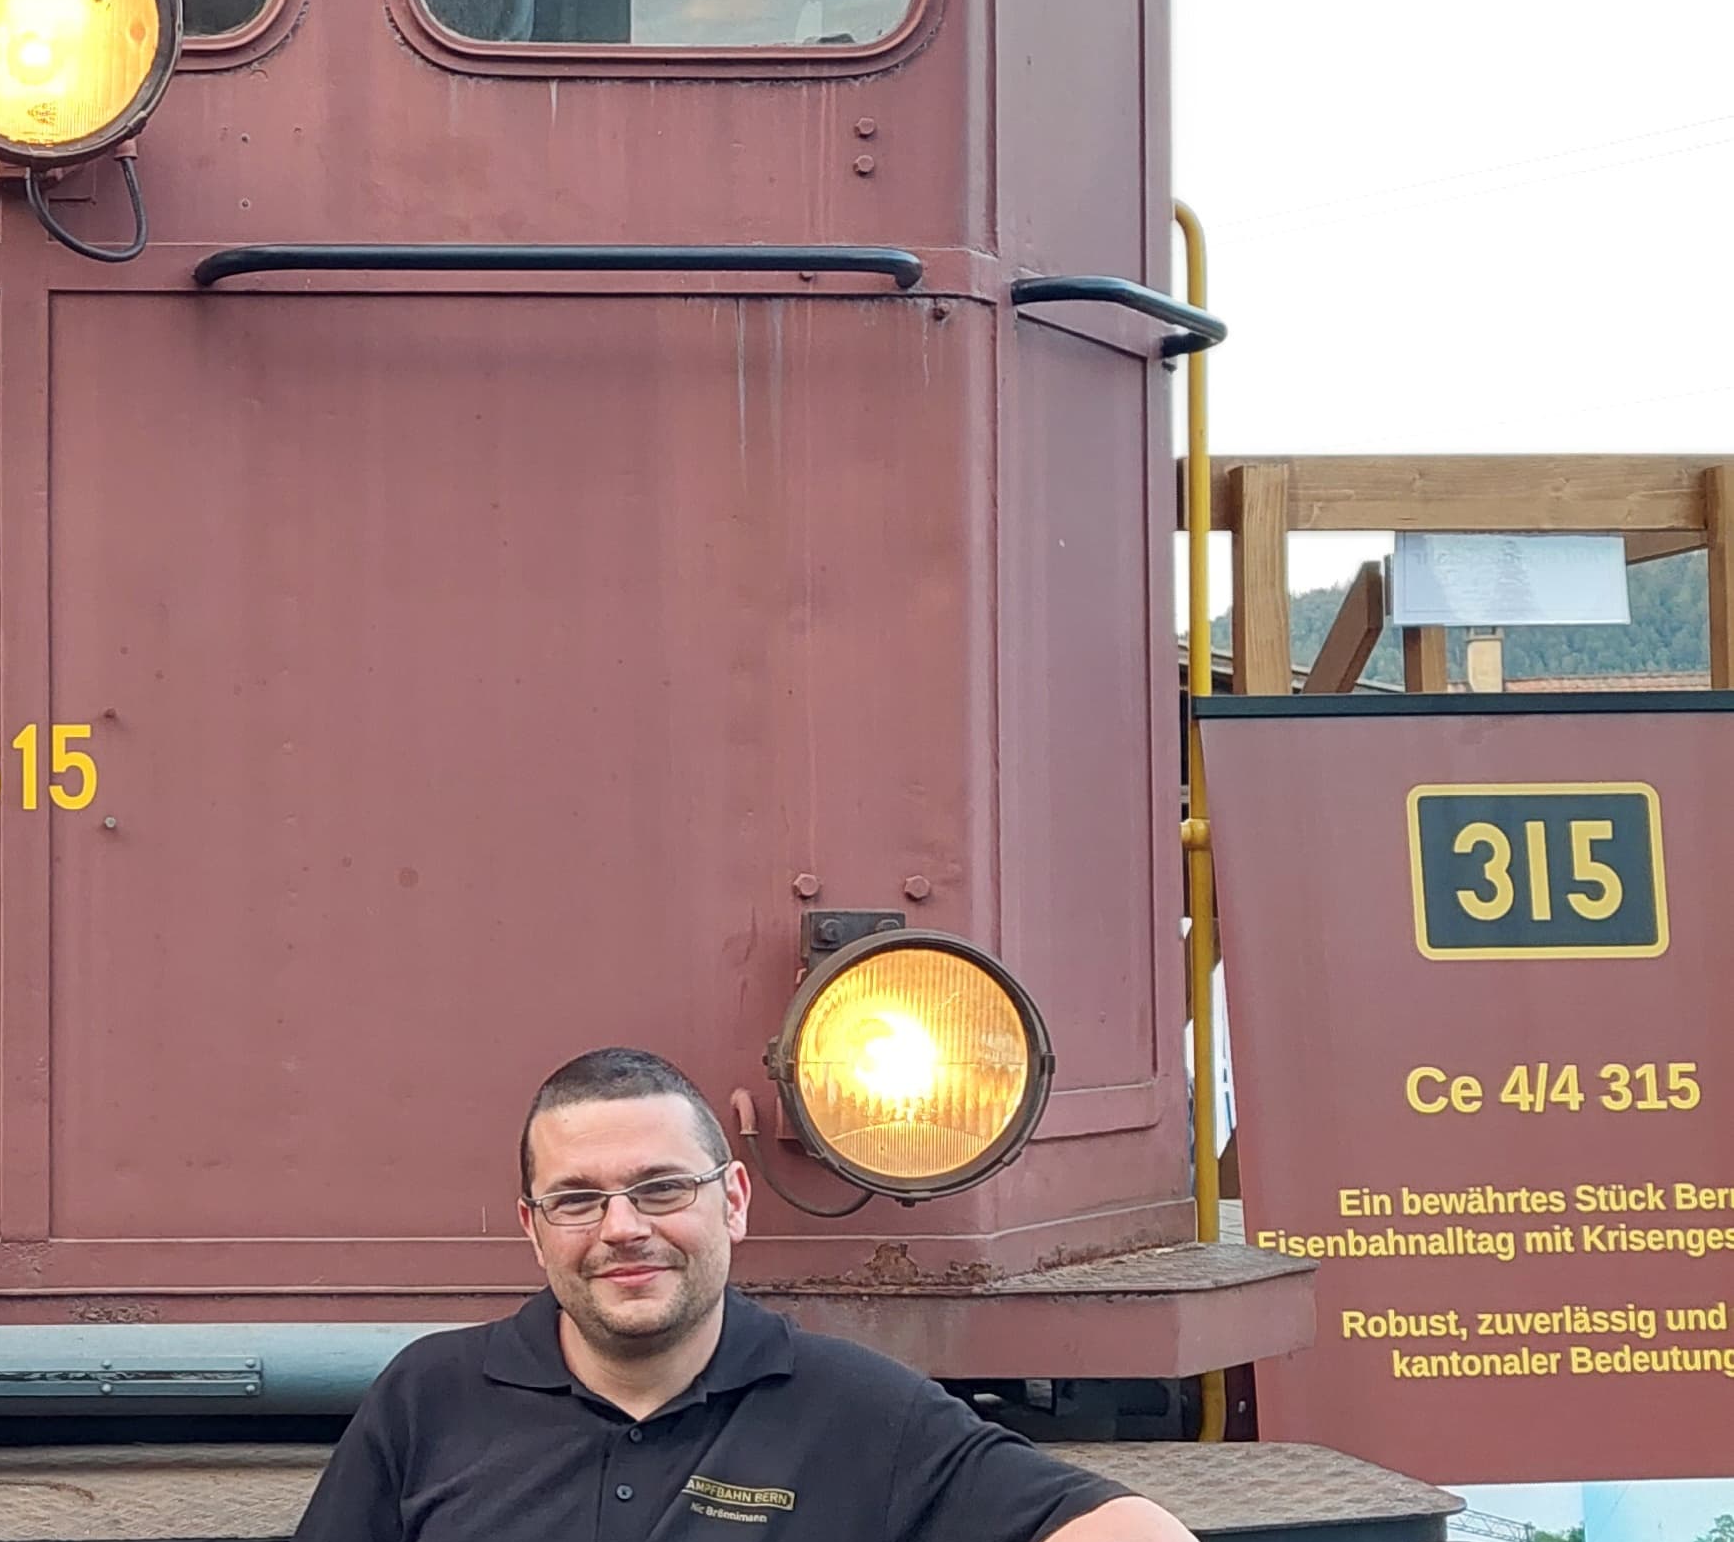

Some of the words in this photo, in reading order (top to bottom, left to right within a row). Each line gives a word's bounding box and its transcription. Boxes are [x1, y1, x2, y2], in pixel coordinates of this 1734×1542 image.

[1453, 820, 1624, 921] 315
[1406, 1066, 1483, 1114] Ce
[1500, 1062, 1585, 1113] 4/4
[1599, 1062, 1702, 1112] 315
[1338, 1187, 1393, 1217] Ein
[1401, 1185, 1566, 1215] bewährtes
[1575, 1182, 1667, 1212] Stück
[1674, 1182, 1734, 1210] Ber
[1257, 1226, 1516, 1261] Eisenbahnalltag
[1524, 1224, 1575, 1253] mit
[1341, 1309, 1468, 1341] Robust,
[1477, 1303, 1657, 1339] zuverlässig
[1666, 1301, 1727, 1331] und
[1392, 1346, 1561, 1378] kantonaler
[1570, 1344, 1734, 1378] Bedeutung
[686, 1478, 752, 1503] AMPFBAHN
[754, 1490, 788, 1505] BERN
